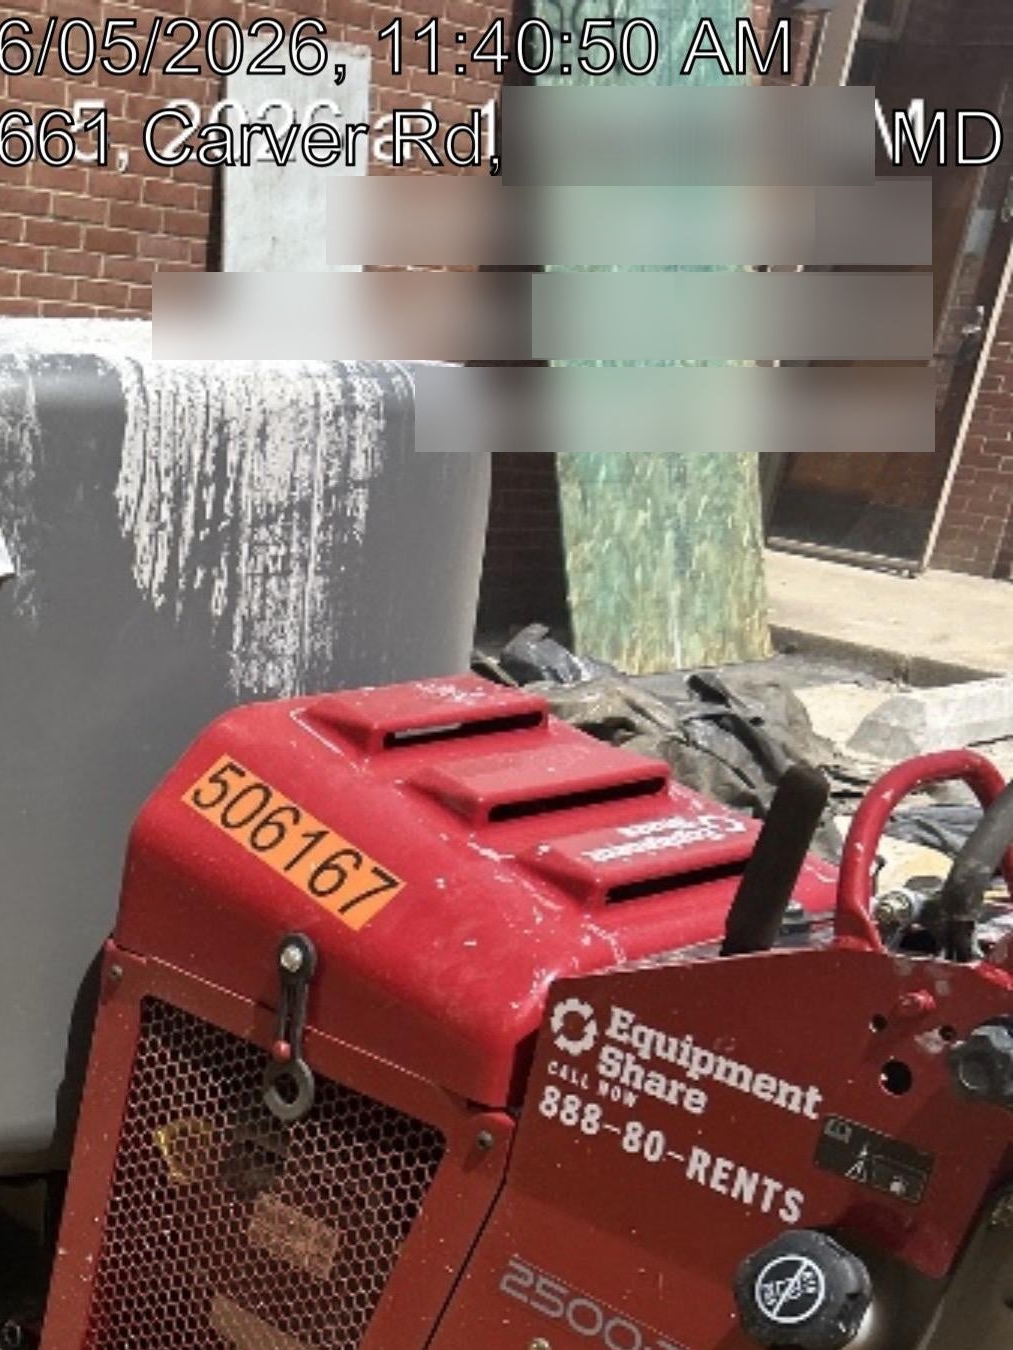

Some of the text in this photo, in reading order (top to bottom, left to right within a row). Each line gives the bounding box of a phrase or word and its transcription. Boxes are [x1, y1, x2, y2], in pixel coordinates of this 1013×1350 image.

[191, 761, 400, 916] 506167
[547, 1060, 638, 1108] CALL NOW
[597, 1045, 708, 1115] Share
[605, 1005, 823, 1120] Equipment
[539, 1084, 805, 1224] 888-80-RENTS
